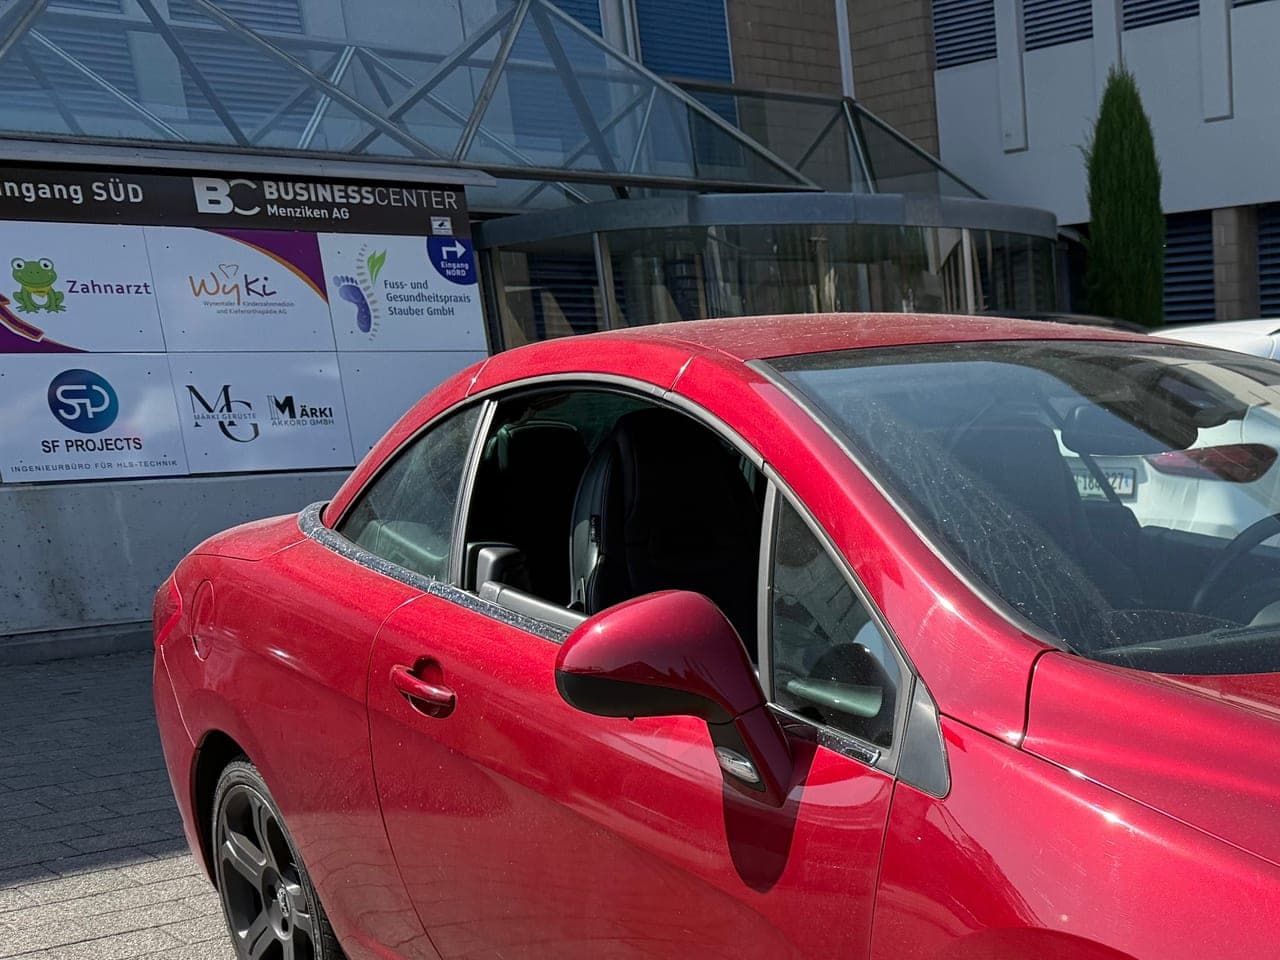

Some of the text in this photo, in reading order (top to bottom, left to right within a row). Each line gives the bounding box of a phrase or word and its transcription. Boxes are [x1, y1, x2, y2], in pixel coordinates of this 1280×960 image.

[0, 178, 143, 204] ngang SÜD
[192, 176, 261, 216] BC
[263, 180, 459, 210] BUSINESSCENTER
[267, 203, 350, 219] Menziken AG
[440, 260, 470, 271] Eingang
[446, 269, 466, 277] NORD
[66, 280, 152, 295] Zahnarzt
[384, 280, 429, 289] Fuss- und
[386, 292, 471, 304] Gesundheitspraxis
[388, 306, 455, 316] Stauber GmbH
[271, 419, 308, 427] AKKORD
[41, 437, 143, 454] SF PROJECTS
[11, 459, 178, 473] INGENIEURBÜRO FÜR HLS-TECHNIK
